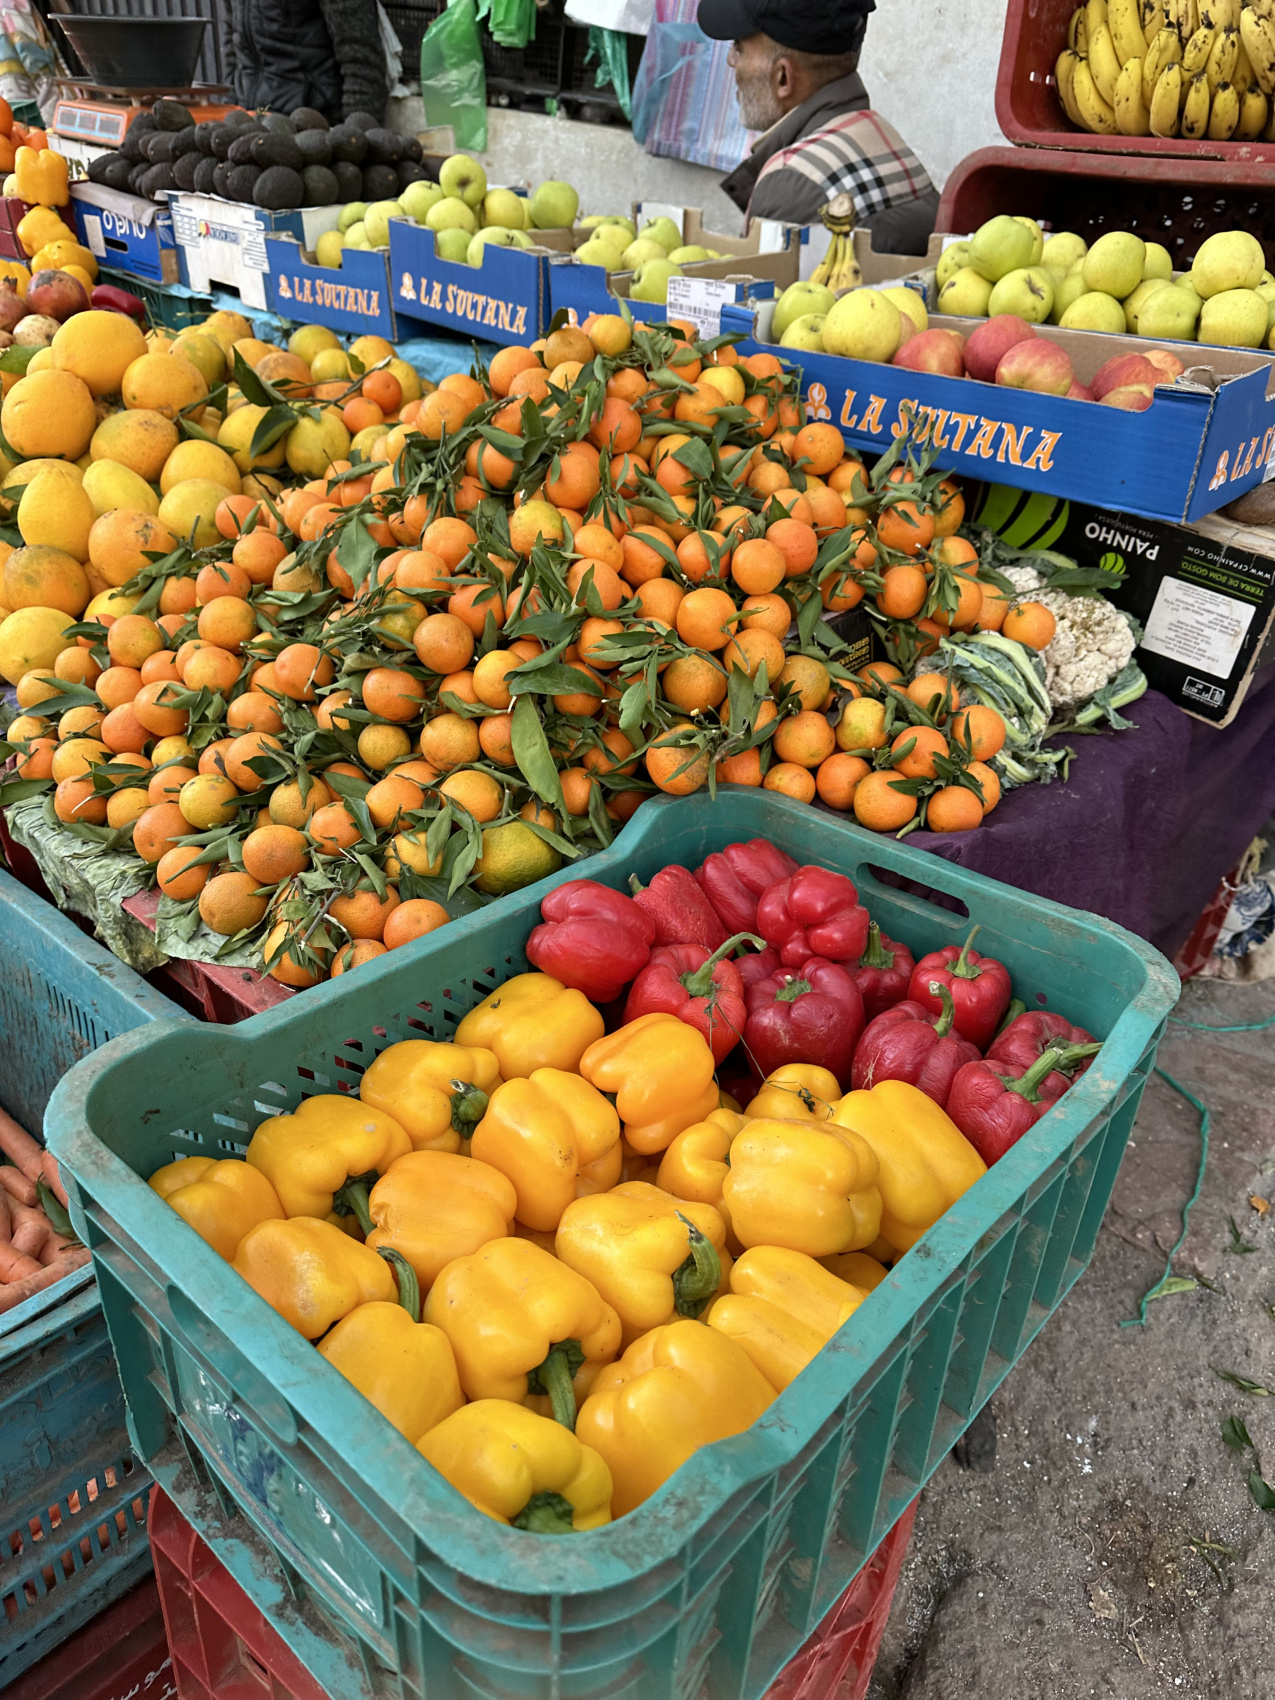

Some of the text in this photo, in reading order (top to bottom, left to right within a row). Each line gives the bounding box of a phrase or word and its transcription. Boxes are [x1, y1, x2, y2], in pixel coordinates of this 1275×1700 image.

[294, 276, 380, 317] LA SULTANA
[420, 277, 527, 335] LA SULTANA
[840, 388, 1063, 472] LA SULTANA
[1230, 436, 1260, 482] LA
[1085, 522, 1160, 561] PAINHO
[1181, 561, 1208, 577] GOSTO
[1209, 571, 1228, 585] BOM
[1227, 577, 1239, 588] DE
[1240, 582, 1265, 597] TERRA
